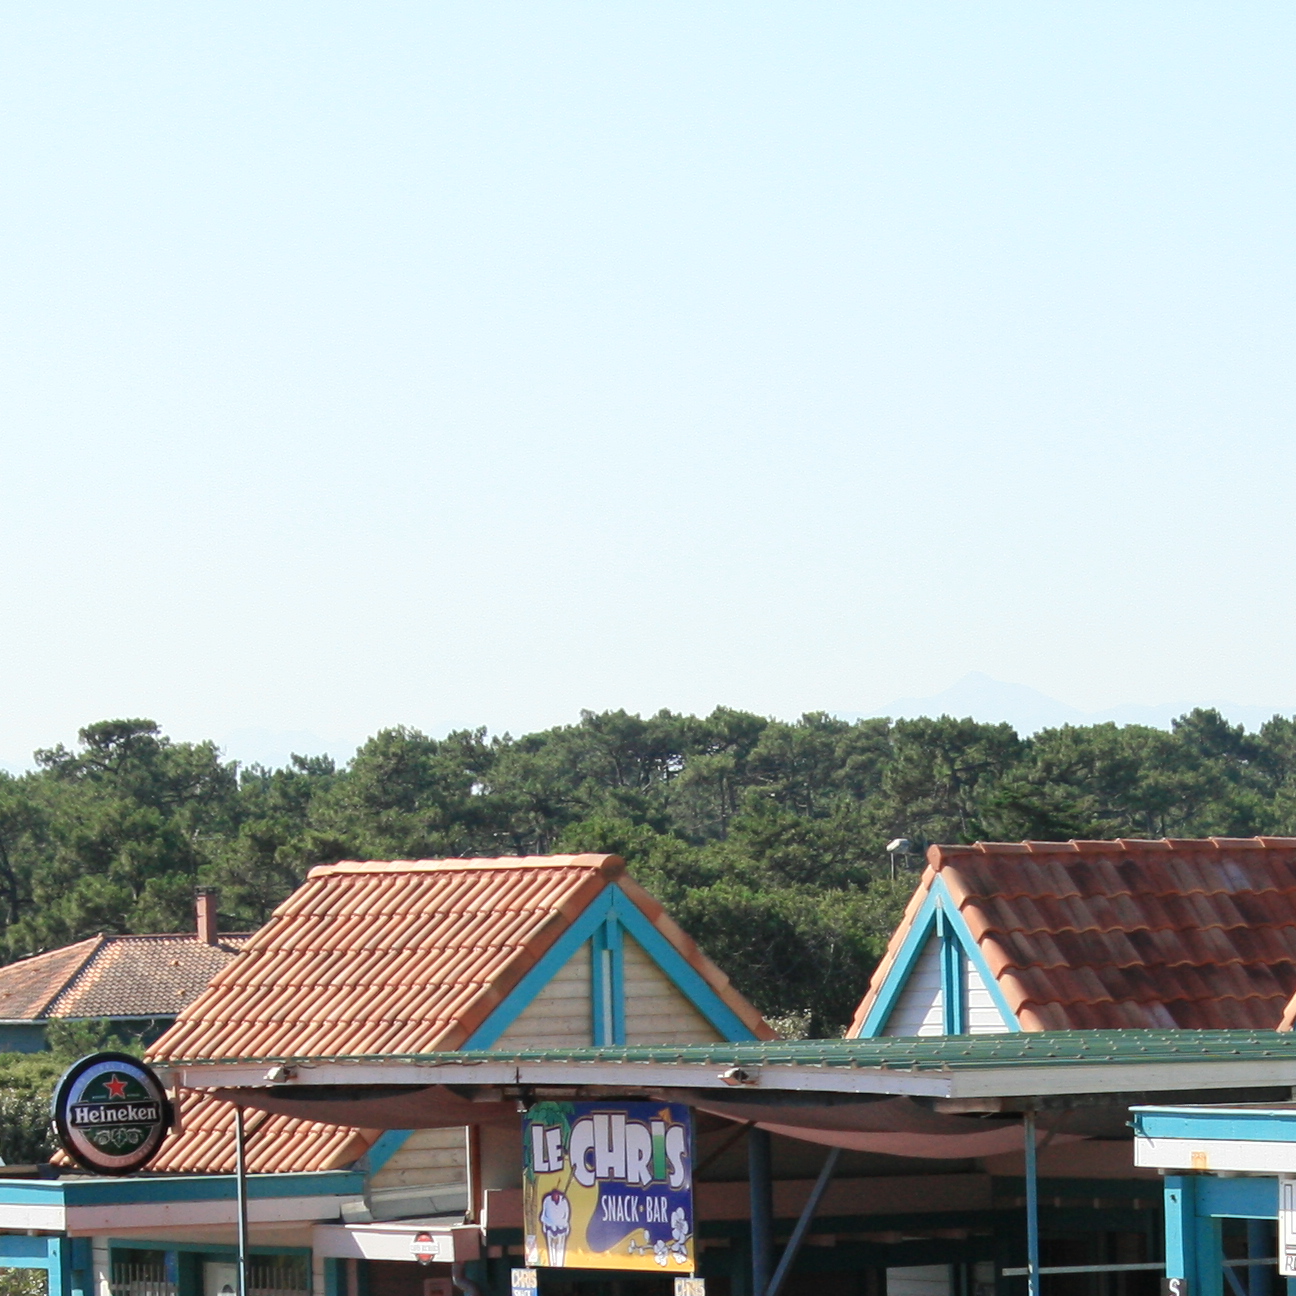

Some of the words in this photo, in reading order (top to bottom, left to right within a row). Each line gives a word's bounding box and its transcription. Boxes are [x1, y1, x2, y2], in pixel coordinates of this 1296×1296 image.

[74, 1104, 157, 1124] Heineken
[531, 1124, 564, 1173] LE
[569, 1110, 688, 1190] CHRIS
[601, 1195, 639, 1223] SNACK
[646, 1195, 668, 1223] BAR
